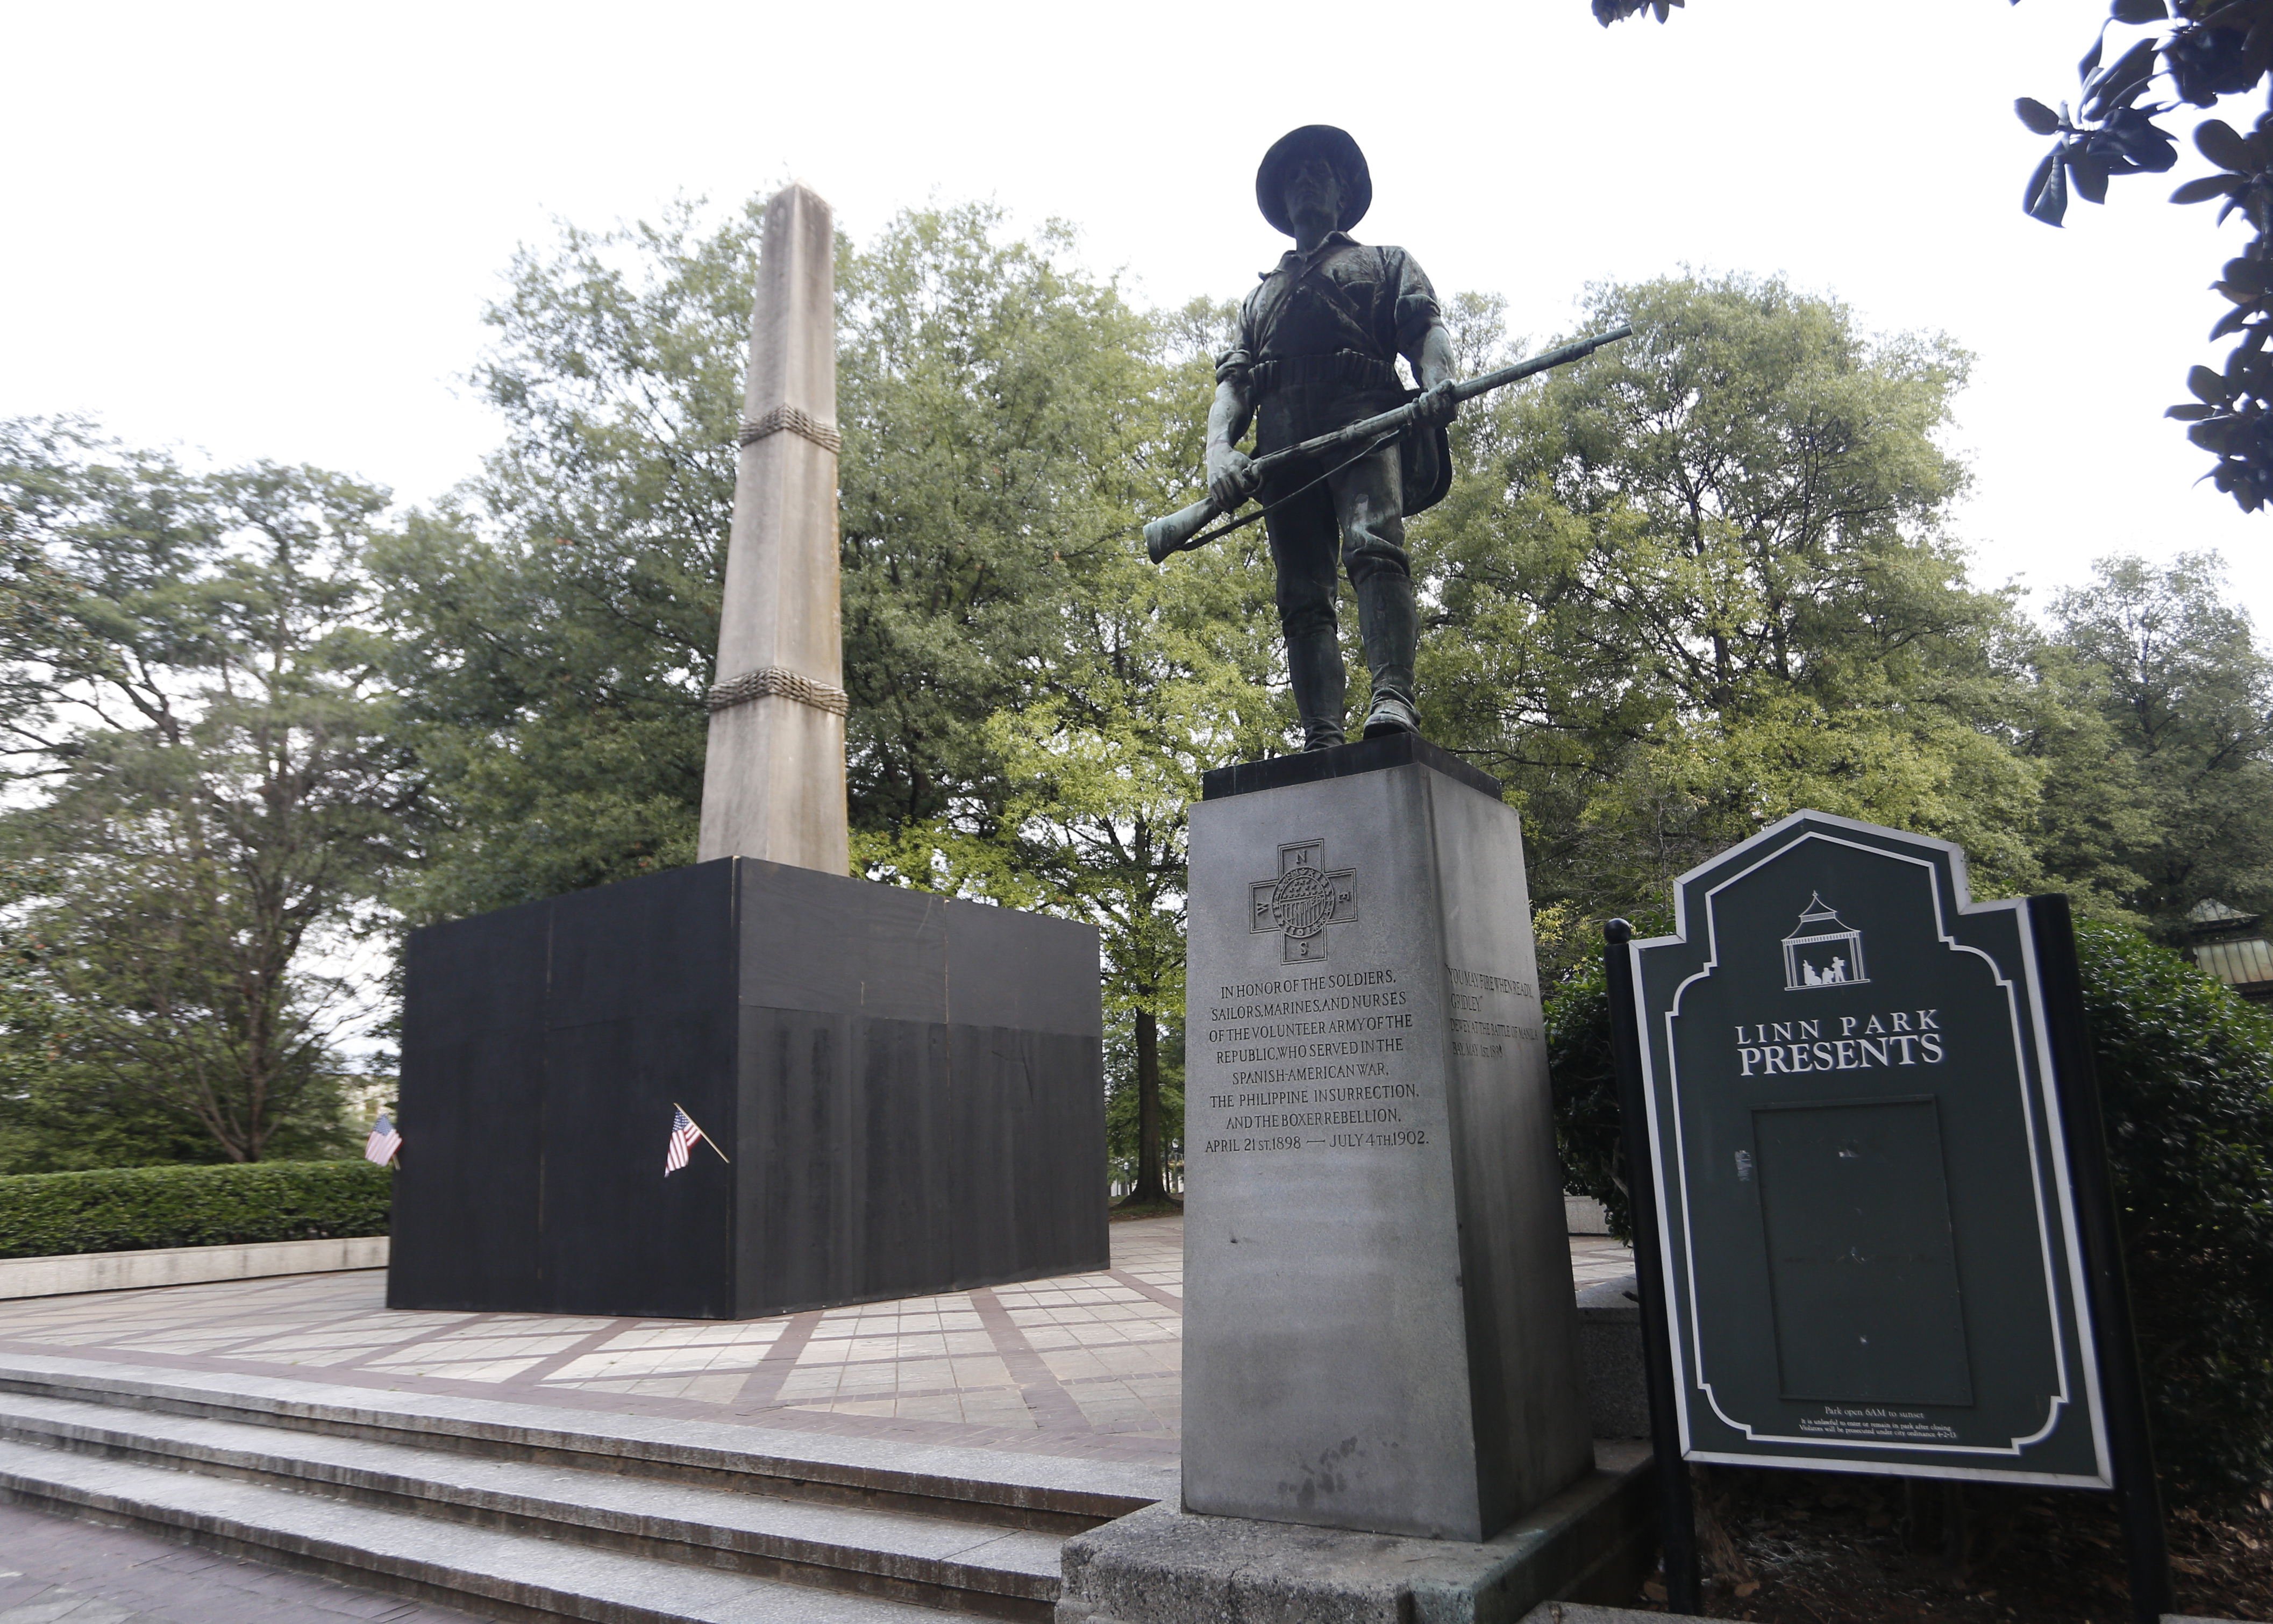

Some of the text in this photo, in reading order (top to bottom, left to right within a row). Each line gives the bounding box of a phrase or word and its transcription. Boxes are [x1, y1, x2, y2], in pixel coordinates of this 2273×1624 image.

[1296, 850, 1307, 864] N
[1300, 942, 1308, 956] S
[1221, 970, 1396, 999] IN HONOR OF THE SOLDIERS,
[1464, 971, 1479, 987] MAY
[1479, 974, 1494, 991] FIRE
[1494, 978, 1512, 994] WHEN
[1212, 992, 1406, 1021] SAILORS, MARINES, AND NURSES
[1210, 1014, 1413, 1042] OF THE VOLUNTEER ARMY OF THE
[1450, 1018, 1470, 1032] DEWEY
[1472, 1021, 1478, 1034] AT
[1479, 1022, 1490, 1035] THE
[1491, 1023, 1510, 1037] BATTLE
[1735, 1009, 1939, 1044] LINN PARK
[1217, 1038, 1403, 1064] REPUBLIC, WHO SERVED IN THE
[1737, 1034, 1943, 1076] PRESENTS
[1232, 1063, 1388, 1085] SPANISH-AMERICAN WAR,
[1210, 1084, 1419, 1108] THE PHILIPPINE INSURRECTION,
[1227, 1116, 1252, 1129] AND
[1255, 1115, 1278, 1128] THE
[1282, 1113, 1323, 1127] BOXER
[1206, 1139, 1239, 1152] APRIL
[1273, 1136, 1301, 1150] 1898
[1329, 1134, 1364, 1147] JULY
[1825, 1406, 1842, 1415] Park
[1865, 1408, 1886, 1416] 6AM
